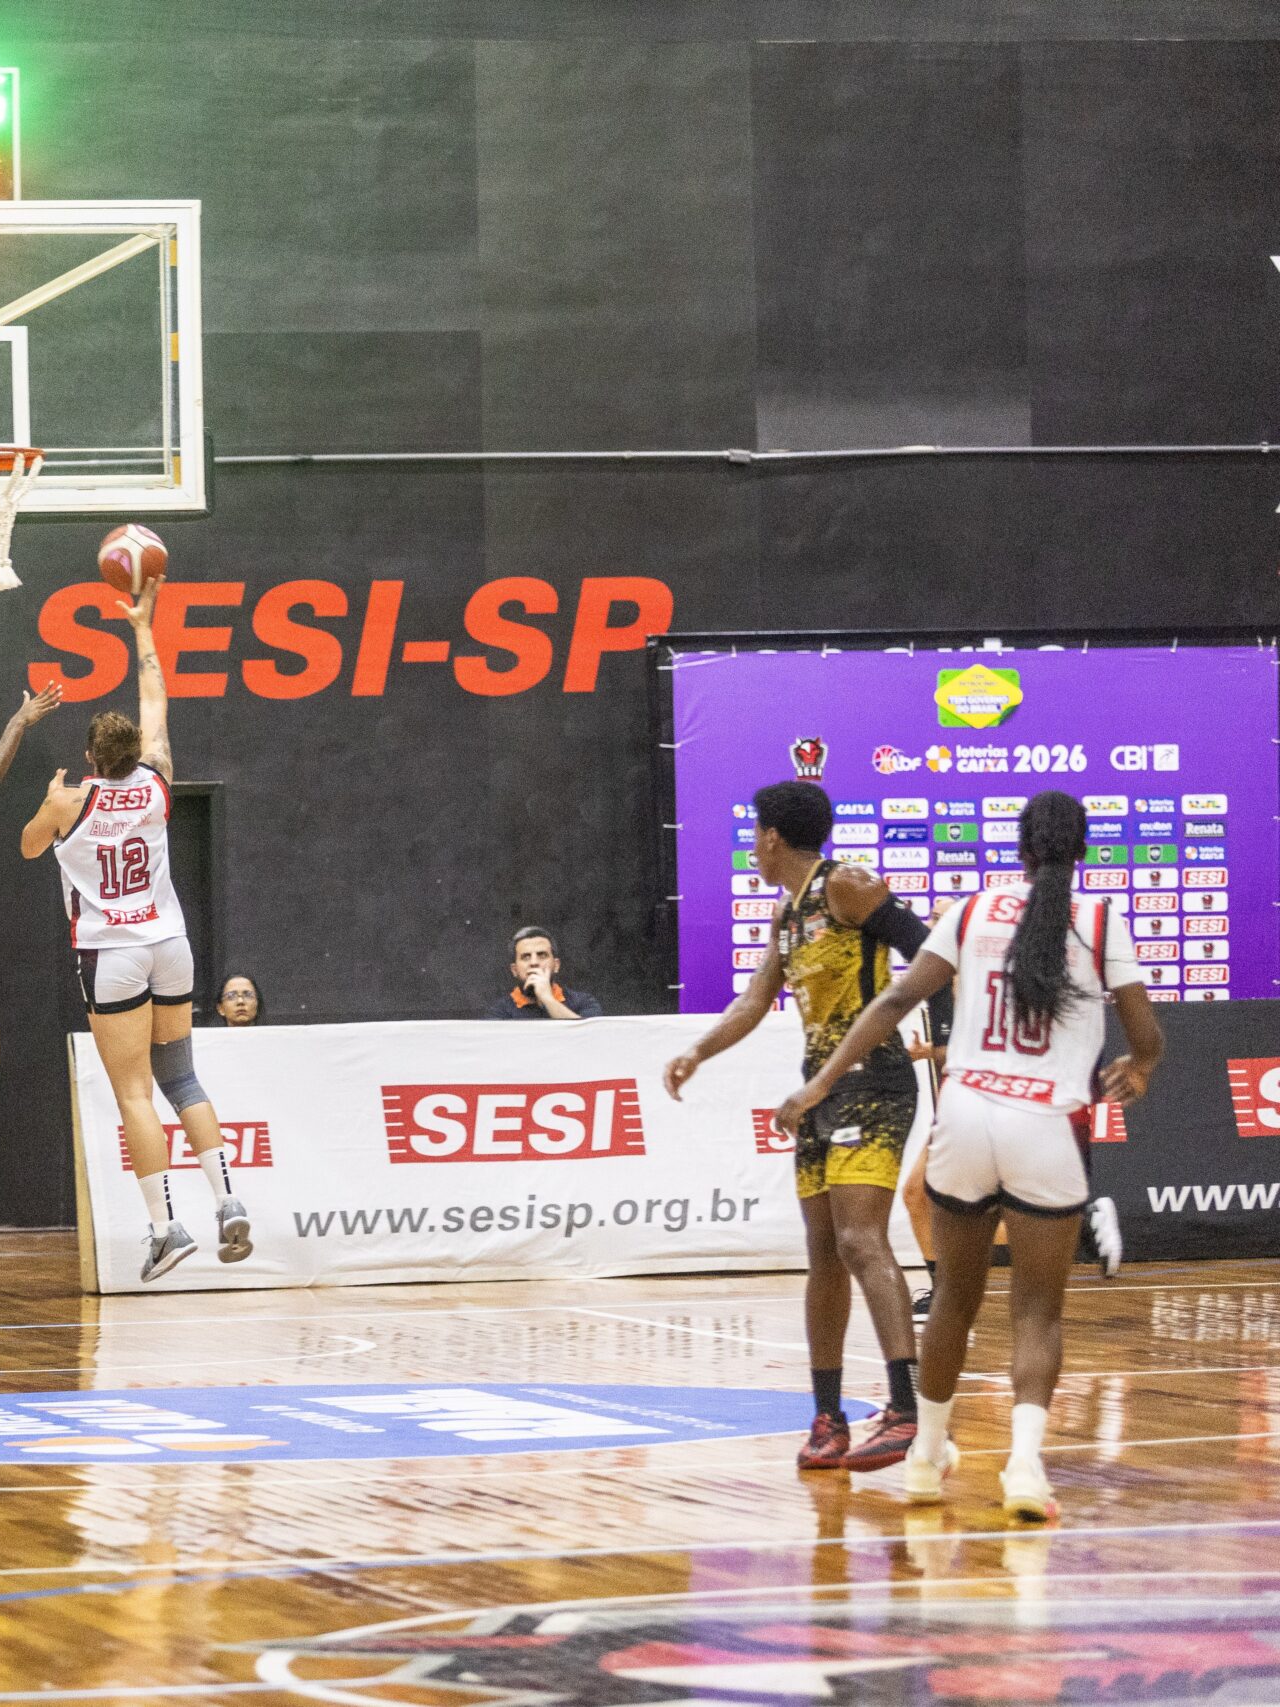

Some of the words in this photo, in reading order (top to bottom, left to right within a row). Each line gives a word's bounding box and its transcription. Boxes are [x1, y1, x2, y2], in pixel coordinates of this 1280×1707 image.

[27, 576, 674, 702] SESI-SP
[956, 744, 1008, 757] loterias
[1013, 744, 1087, 772] 2026
[956, 759, 1008, 773] CAIXA
[102, 788, 148, 811] SESI
[835, 804, 875, 815] CAIXA
[97, 837, 150, 899] 12
[888, 875, 924, 888] SESI
[1088, 873, 1124, 886] SESI
[1188, 872, 1223, 885] SESI
[739, 902, 774, 916] SESI
[1138, 897, 1174, 909] SESI
[1189, 920, 1225, 933] SESI
[1139, 945, 1175, 958] SESI
[1189, 969, 1226, 982] SESI
[410, 1089, 615, 1157] SESI
[293, 1188, 760, 1238] www.sesisp.org.br
